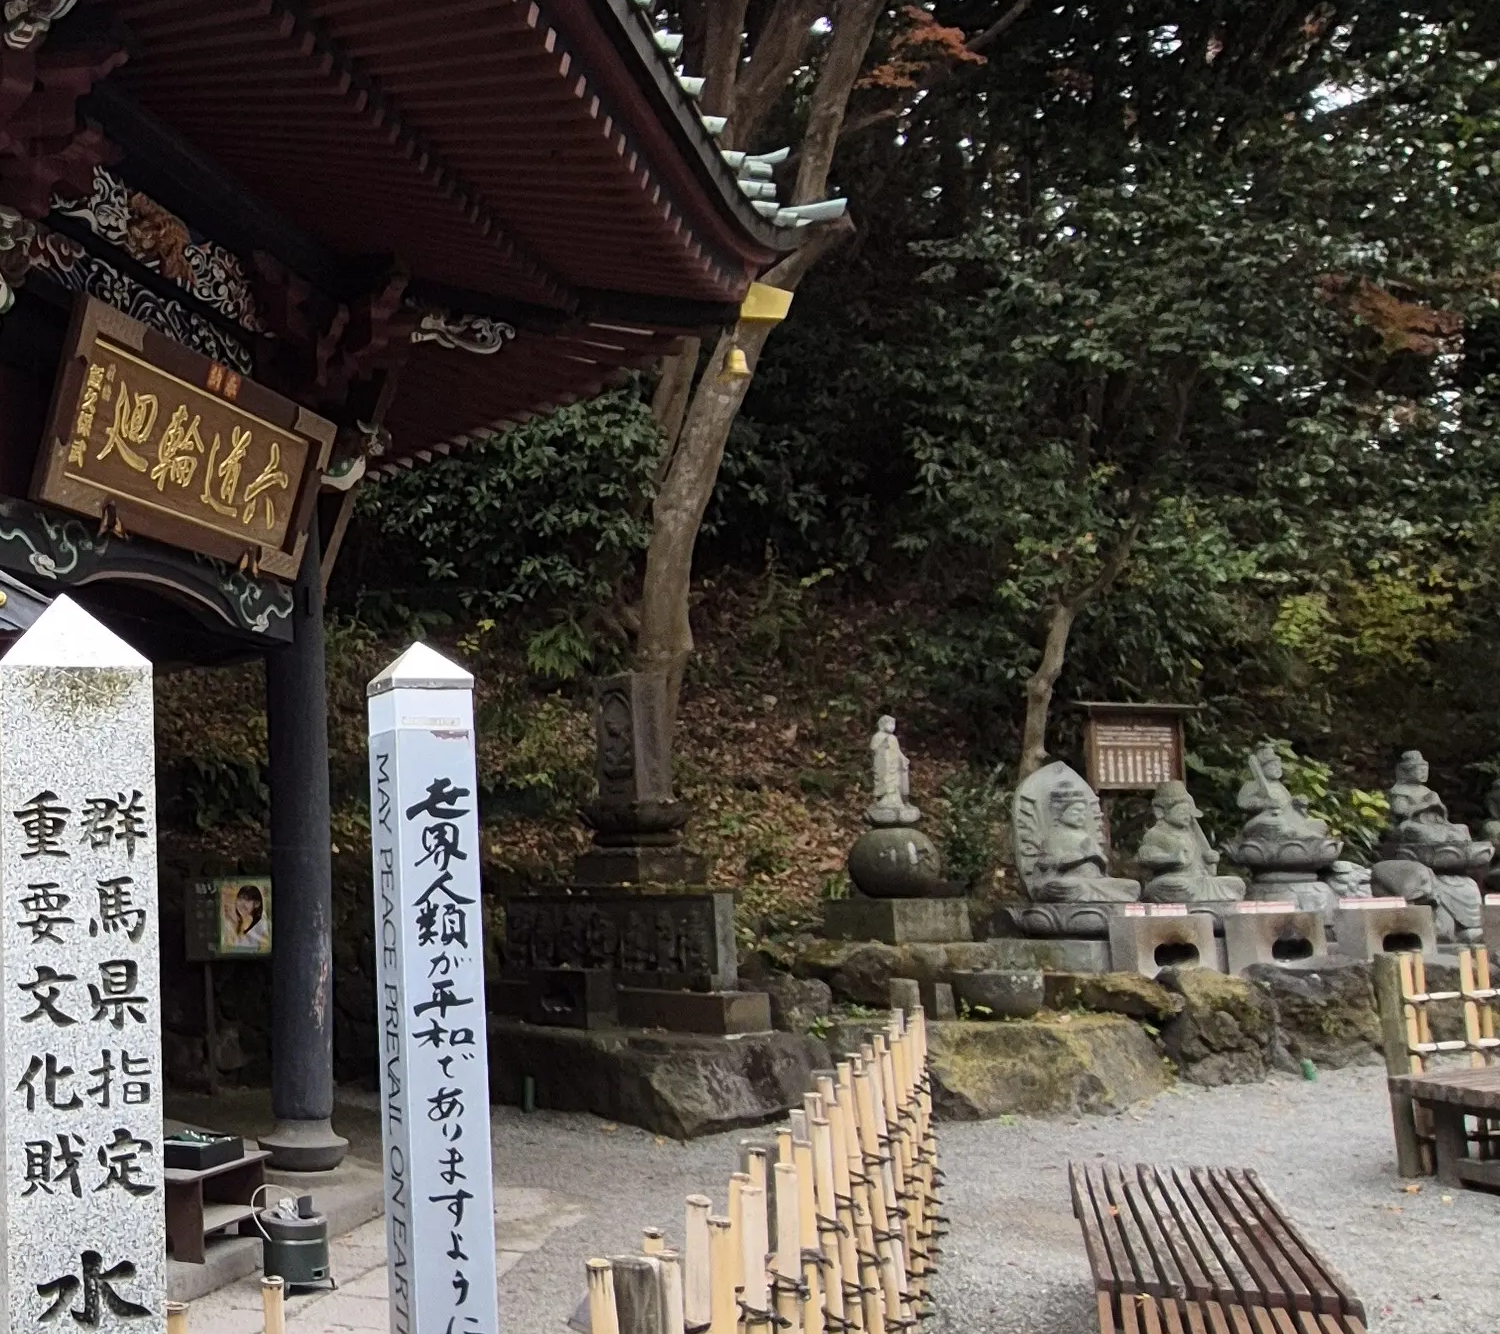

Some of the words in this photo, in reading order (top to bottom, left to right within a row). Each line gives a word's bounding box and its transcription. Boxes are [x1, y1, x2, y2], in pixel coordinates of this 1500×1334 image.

[375, 753, 393, 834] MAY
[379, 848, 398, 969] PEACE
[13, 789, 85, 1199] 重要文化財
[79, 788, 156, 1197] 群馬県指定
[384, 983, 404, 1135] PREVAIL
[389, 1145, 407, 1209] ON
